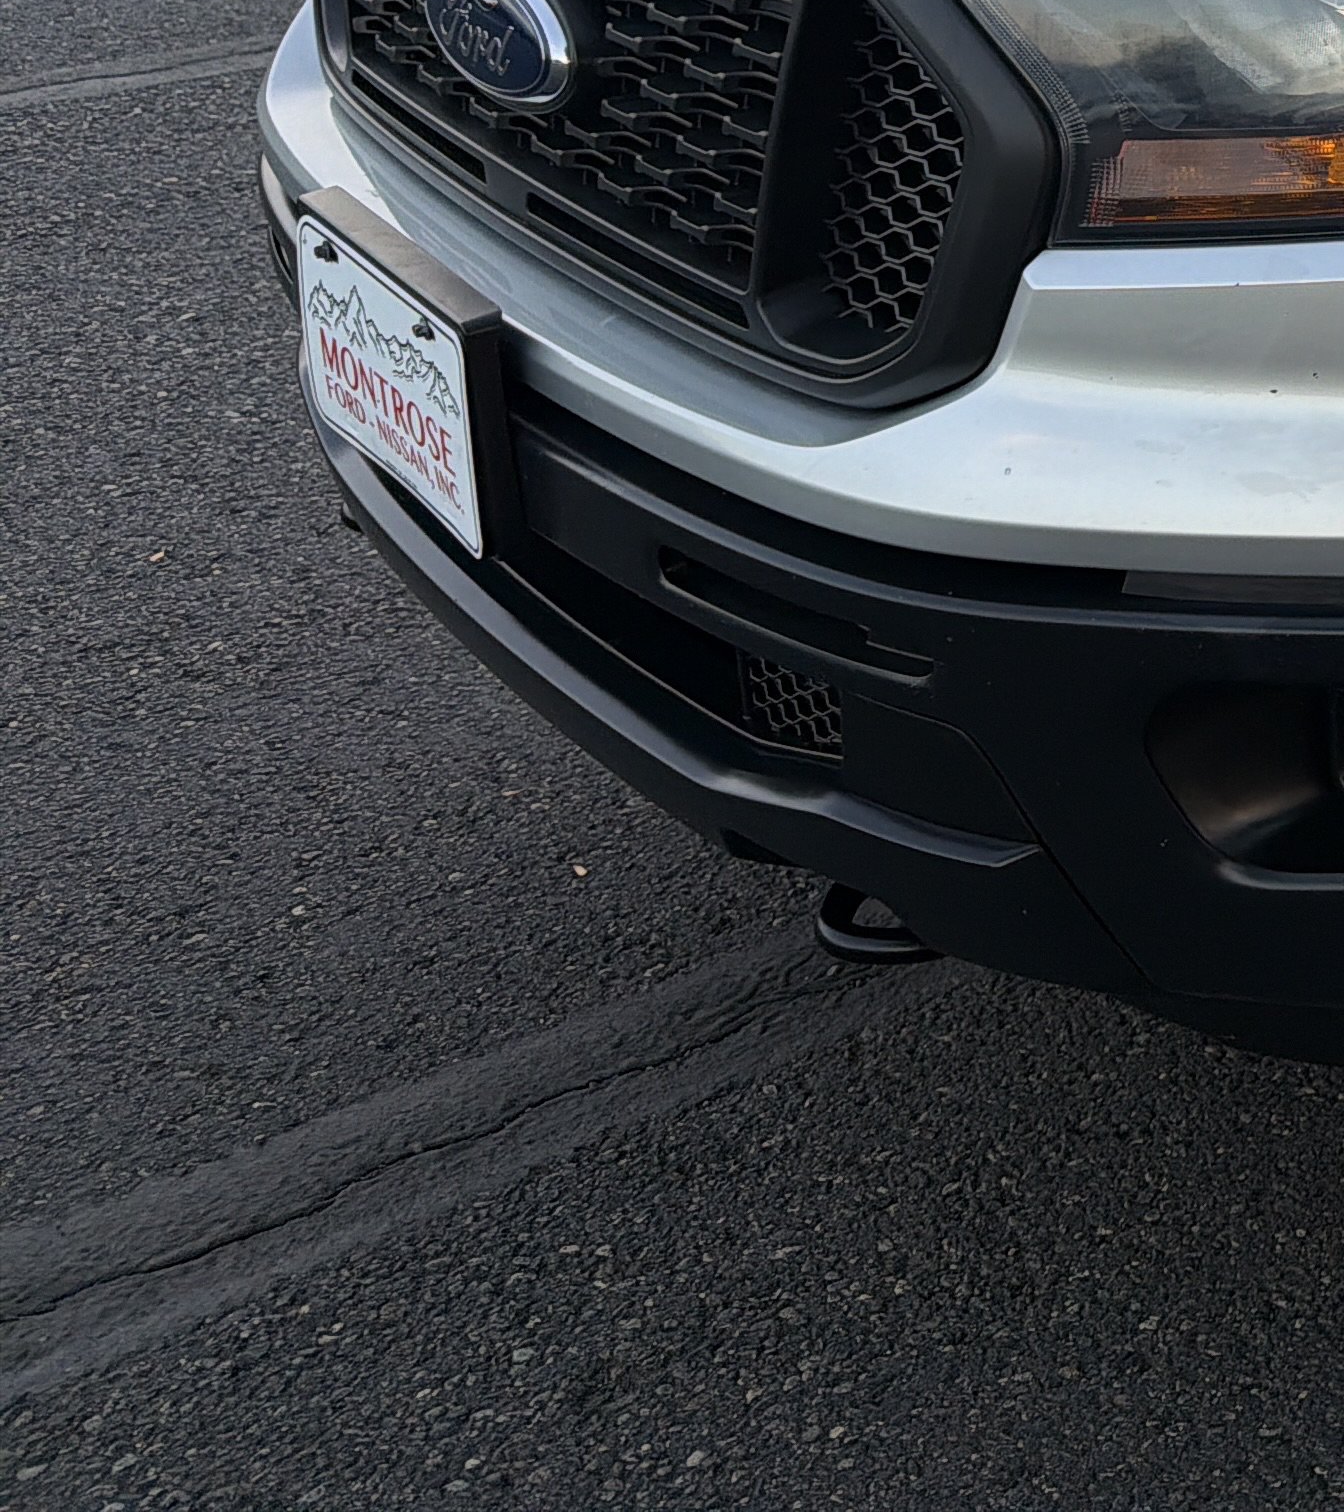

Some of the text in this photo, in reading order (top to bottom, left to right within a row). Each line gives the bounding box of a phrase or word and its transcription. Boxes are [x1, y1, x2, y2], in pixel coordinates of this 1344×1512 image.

[319, 326, 457, 478] MONTROSE
[325, 374, 367, 425] FORD
[434, 465, 466, 515] INC.
